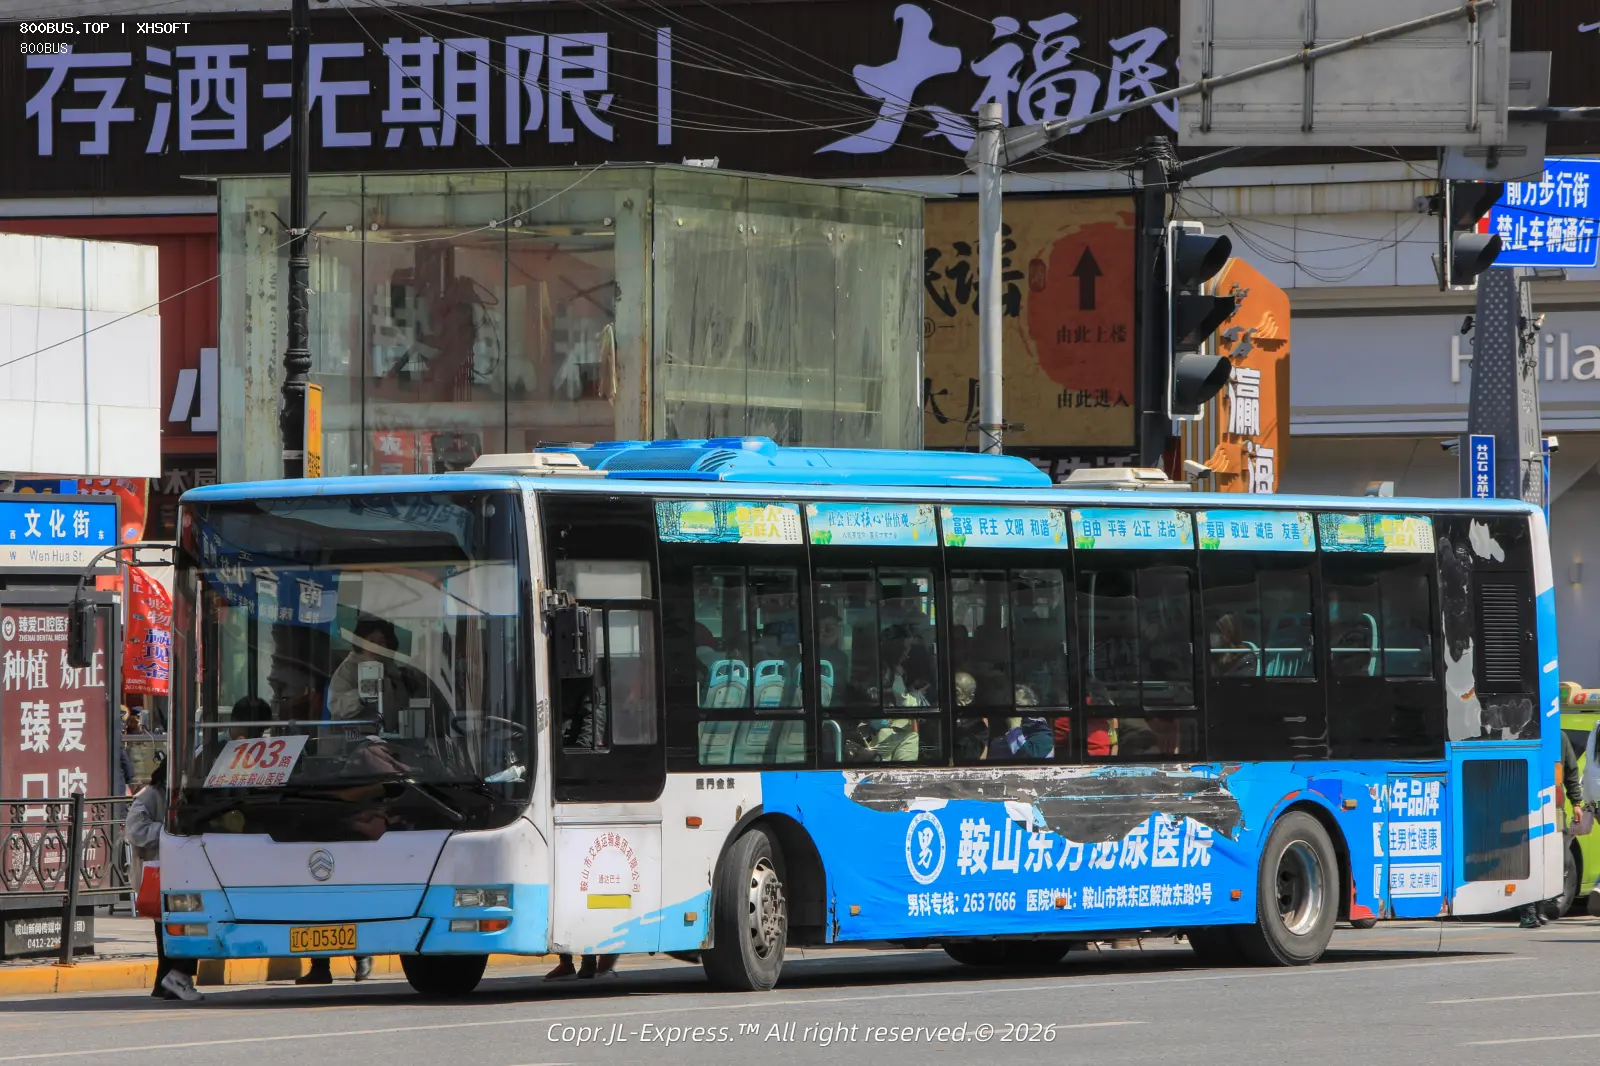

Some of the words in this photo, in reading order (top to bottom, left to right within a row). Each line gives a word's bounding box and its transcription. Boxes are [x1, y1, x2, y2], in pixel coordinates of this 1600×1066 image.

[25, 32, 615, 156] 存酒无期限
[1506, 171, 1590, 209] 前方步行街
[1496, 216, 1594, 254] 禁止车辆通行
[1057, 387, 1130, 409] 由此进入
[24, 508, 90, 539] 文化街
[952, 516, 973, 535] 富强
[979, 517, 998, 536] 民主
[1005, 518, 1024, 536] 文明
[1030, 518, 1050, 537] 和谐
[1082, 519, 1102, 537] 自由
[1107, 519, 1127, 537] 平等
[1133, 519, 1152, 537] 公正
[1158, 519, 1177, 538] 法治
[1206, 521, 1225, 538] 爱国
[1230, 521, 1250, 539] 敬业
[1255, 522, 1274, 539] 诚信
[1281, 522, 1300, 540] 友善
[9, 551, 17, 560] W
[30, 550, 50, 562] Wen
[52, 550, 70, 562] Hua
[72, 550, 85, 562] St.
[3, 648, 49, 691] 种植
[20, 699, 87, 754] 臻爱
[1409, 872, 1438, 889] 定点单位
[987, 892, 1017, 912] 7666
